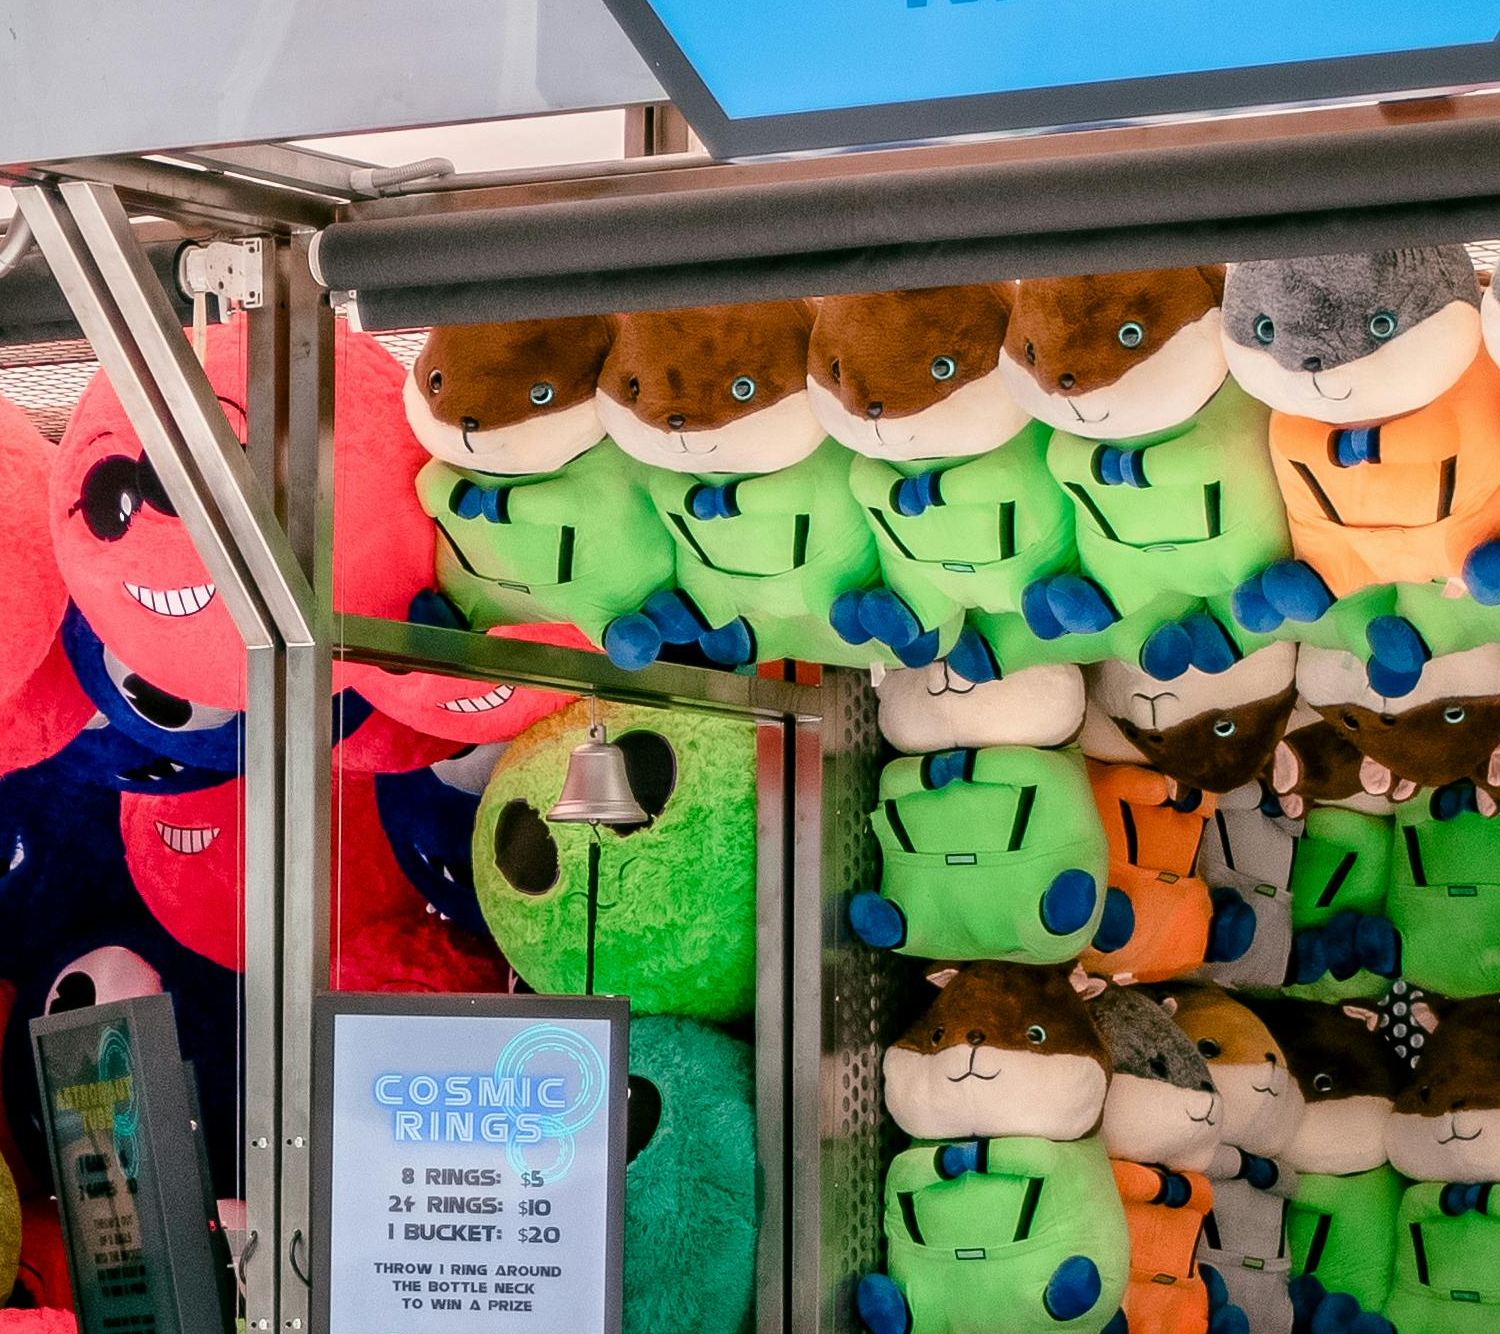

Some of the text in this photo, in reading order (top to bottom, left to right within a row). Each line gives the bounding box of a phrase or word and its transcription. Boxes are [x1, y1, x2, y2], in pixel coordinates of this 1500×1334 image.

[375, 1075, 566, 1108] COSMIC
[395, 1111, 542, 1143] RINGS
[401, 1168, 544, 1188] 8 RINGS: $5
[388, 1195, 551, 1217] 24 RINGS: $10
[404, 1223, 502, 1242] BUCKET:
[517, 1226, 561, 1244] $20
[374, 1262, 432, 1275] THROW
[450, 1264, 488, 1276] RING
[495, 1265, 562, 1278] AROUND
[393, 1280, 535, 1294] THE BOTTLE NECK
[402, 1298, 532, 1312] TO WIN A PRIZE
